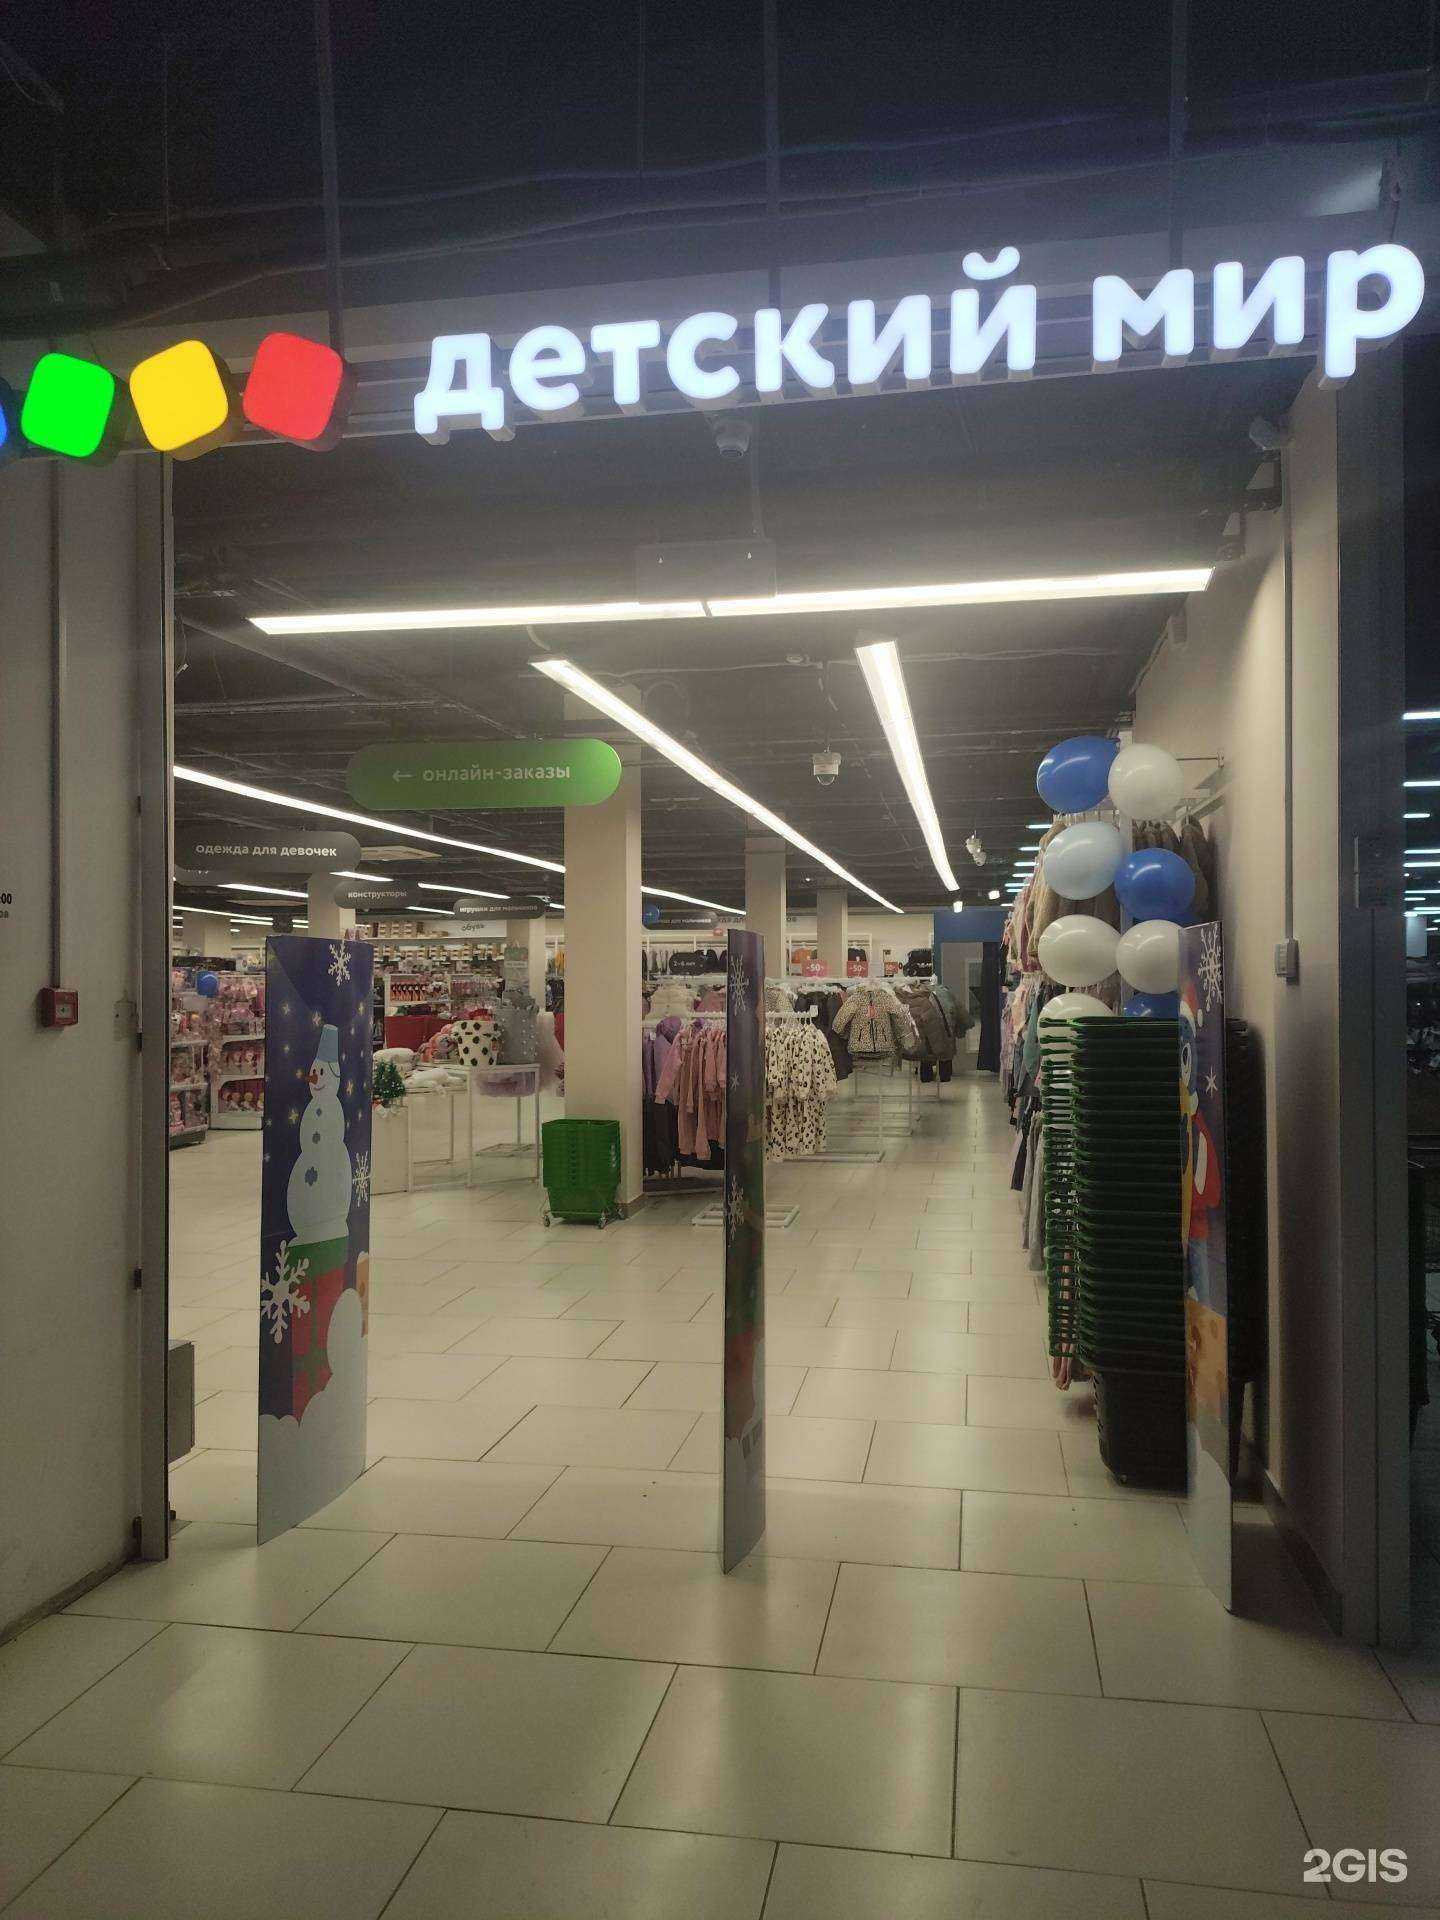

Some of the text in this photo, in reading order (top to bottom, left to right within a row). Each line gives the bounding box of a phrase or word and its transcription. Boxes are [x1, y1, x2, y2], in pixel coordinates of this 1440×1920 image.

[413, 242, 1425, 436] детский мир
[422, 764, 571, 782] онлайн-заказы
[195, 844, 337, 857] одежда для девочек
[347, 890, 407, 899] конструкторы
